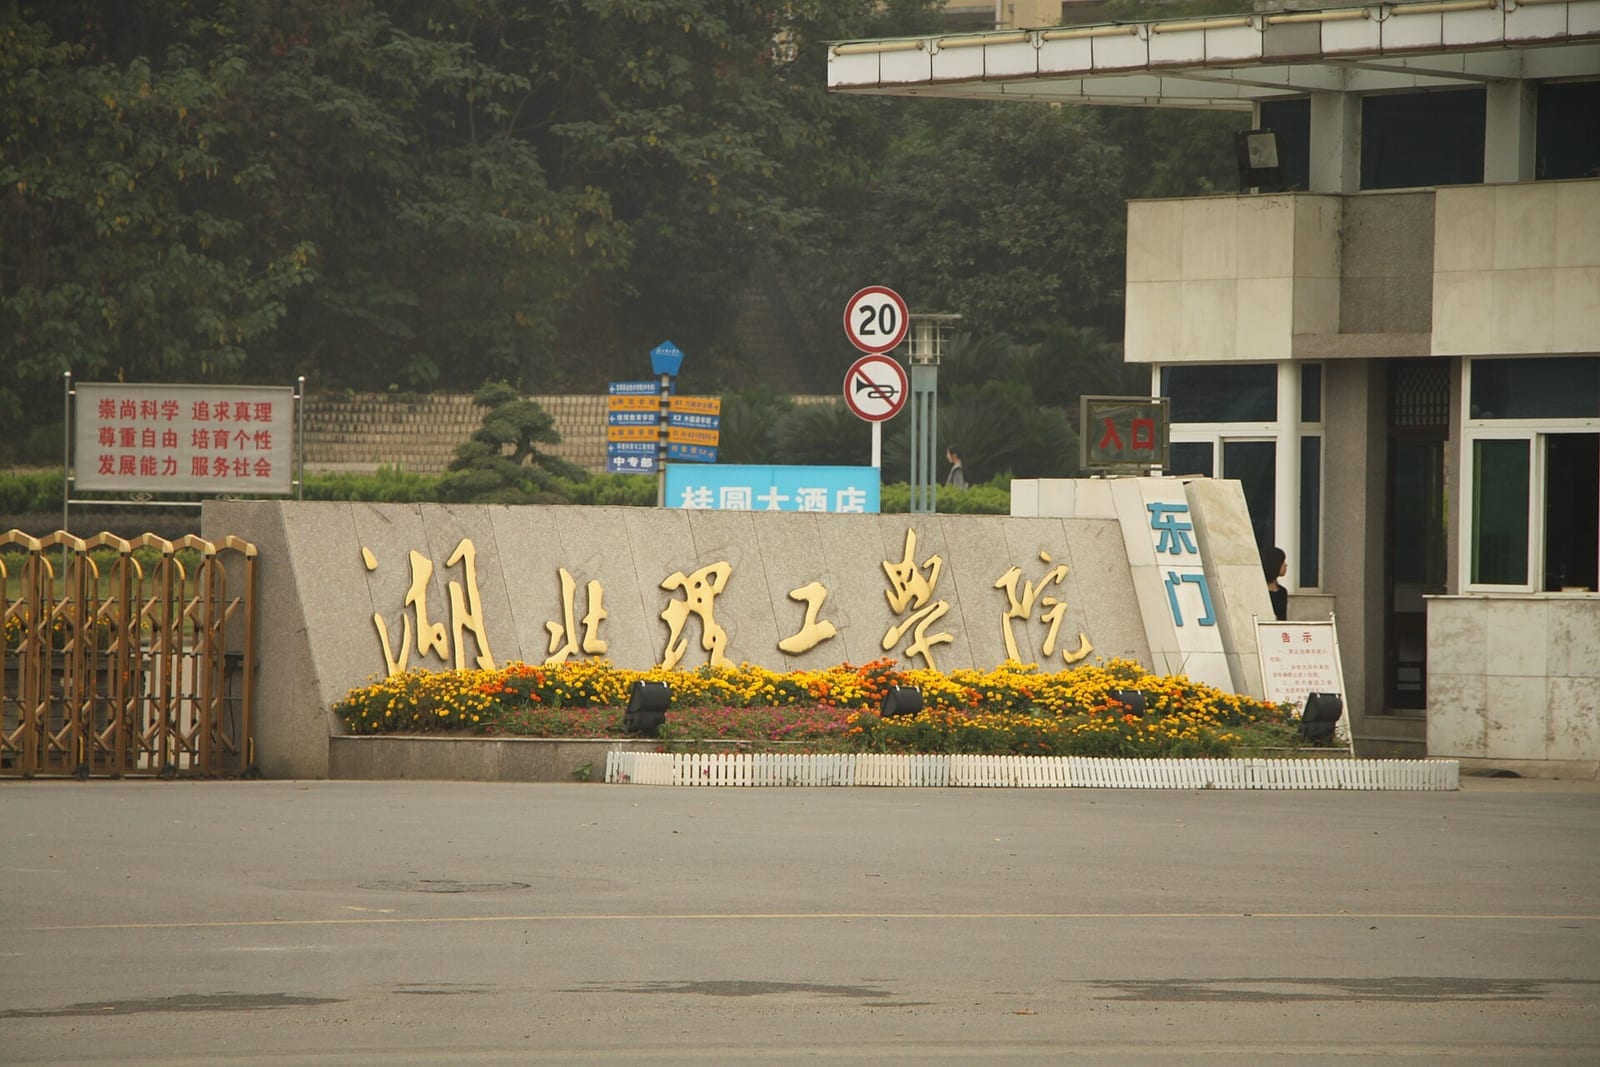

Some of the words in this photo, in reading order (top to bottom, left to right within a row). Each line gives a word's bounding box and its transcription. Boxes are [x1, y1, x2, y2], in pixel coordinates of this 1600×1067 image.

[859, 303, 896, 336] 20
[98, 399, 179, 421] 崇尚科学
[191, 401, 273, 422] 追求真理
[98, 427, 178, 449] 尊重自由
[191, 428, 273, 450] 培育个性
[1100, 417, 1155, 450] 入口
[98, 455, 178, 477] 发展能力
[191, 456, 272, 478] 服务社会
[1146, 502, 1216, 627] 东门
[1281, 632, 1312, 643] 告示
